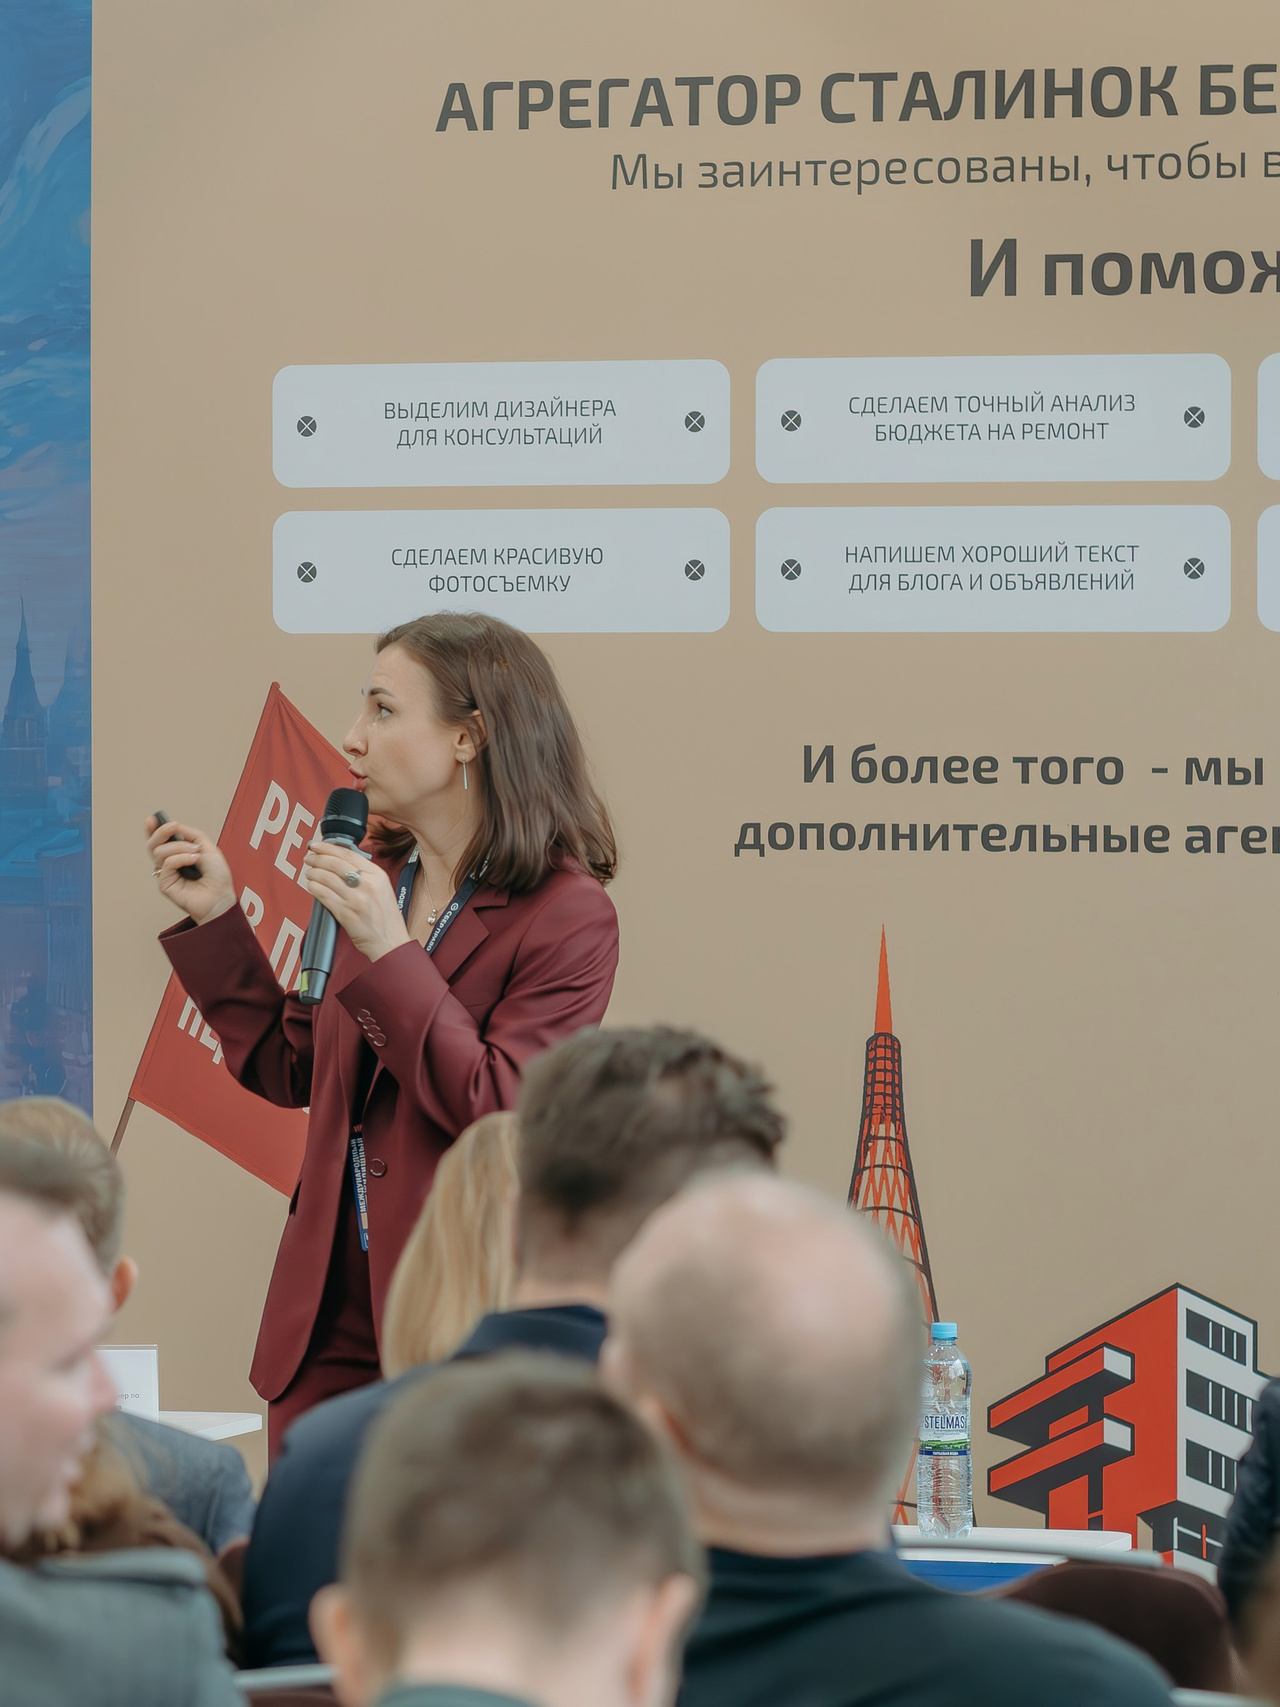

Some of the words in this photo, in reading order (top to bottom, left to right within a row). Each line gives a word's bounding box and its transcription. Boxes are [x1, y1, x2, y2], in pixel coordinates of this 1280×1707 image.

[435, 74, 802, 133] АГРЕГАТОР
[820, 66, 1179, 124] СТАЛИНОК
[611, 153, 683, 190] Мы
[697, 154, 1091, 196] заинтересованы,
[1107, 140, 1246, 181] чтобы
[970, 238, 1018, 298] И
[384, 401, 489, 420] ВЫДЕЛИМ
[494, 395, 617, 419] ДИЗАЙНЕРА
[848, 396, 948, 418] СДЕЛАЕМ
[954, 390, 1045, 414] ТОЧНЫЙ
[1050, 394, 1136, 413] АНАЛИЗ
[396, 428, 438, 450] ДЛЯ
[444, 423, 603, 447] КОНСУЛЬТАЦИЙ
[875, 423, 982, 445] БЮДЖЕТА
[988, 424, 1016, 441] НА
[1021, 422, 1110, 441] РЕМОНТ
[391, 548, 487, 569] СДЕЛАЕМ
[494, 547, 604, 565] КРАСИВУЮ
[845, 545, 955, 564] НАПИШЕМ
[961, 540, 1068, 563] ХОРОШИЙ
[1075, 544, 1140, 563] ТЕКСТ
[428, 574, 571, 594] ФОТОСЪЕМКУ
[848, 573, 891, 595] ДЛЯ
[898, 573, 964, 591] БЛОГА
[969, 573, 983, 591] И
[989, 568, 1134, 591] ОБЪЯВЛЕНИЙ
[803, 744, 835, 784] И
[850, 742, 999, 785] более
[1012, 755, 1124, 786] того
[1184, 757, 1264, 786] мы
[733, 821, 1171, 858] дополнительные
[397, 886, 407, 909] GROUP
[924, 1415, 966, 1430] STELMAS
